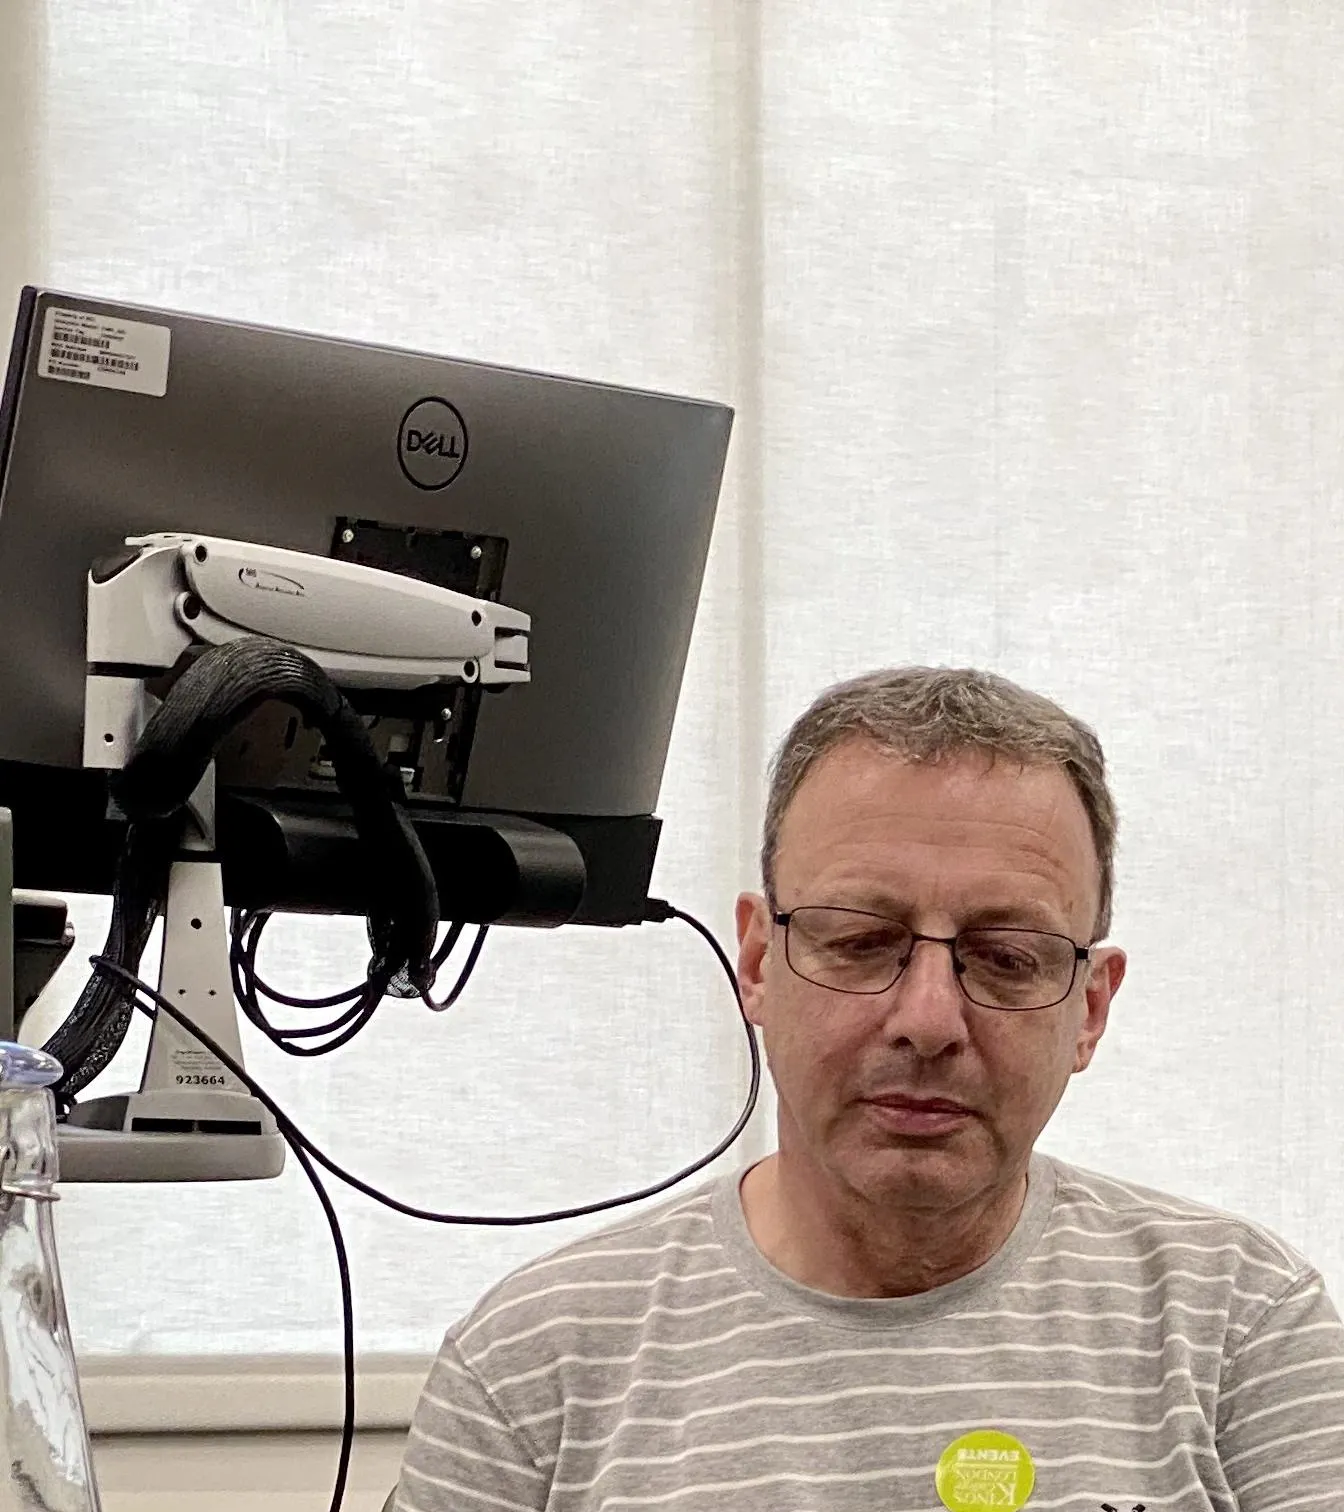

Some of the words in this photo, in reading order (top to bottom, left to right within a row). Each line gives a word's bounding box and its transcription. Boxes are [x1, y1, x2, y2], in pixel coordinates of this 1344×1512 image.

[406, 429, 460, 459] DELL
[175, 1075, 225, 1085] 923664
[956, 1448, 1020, 1462] EVENTS
